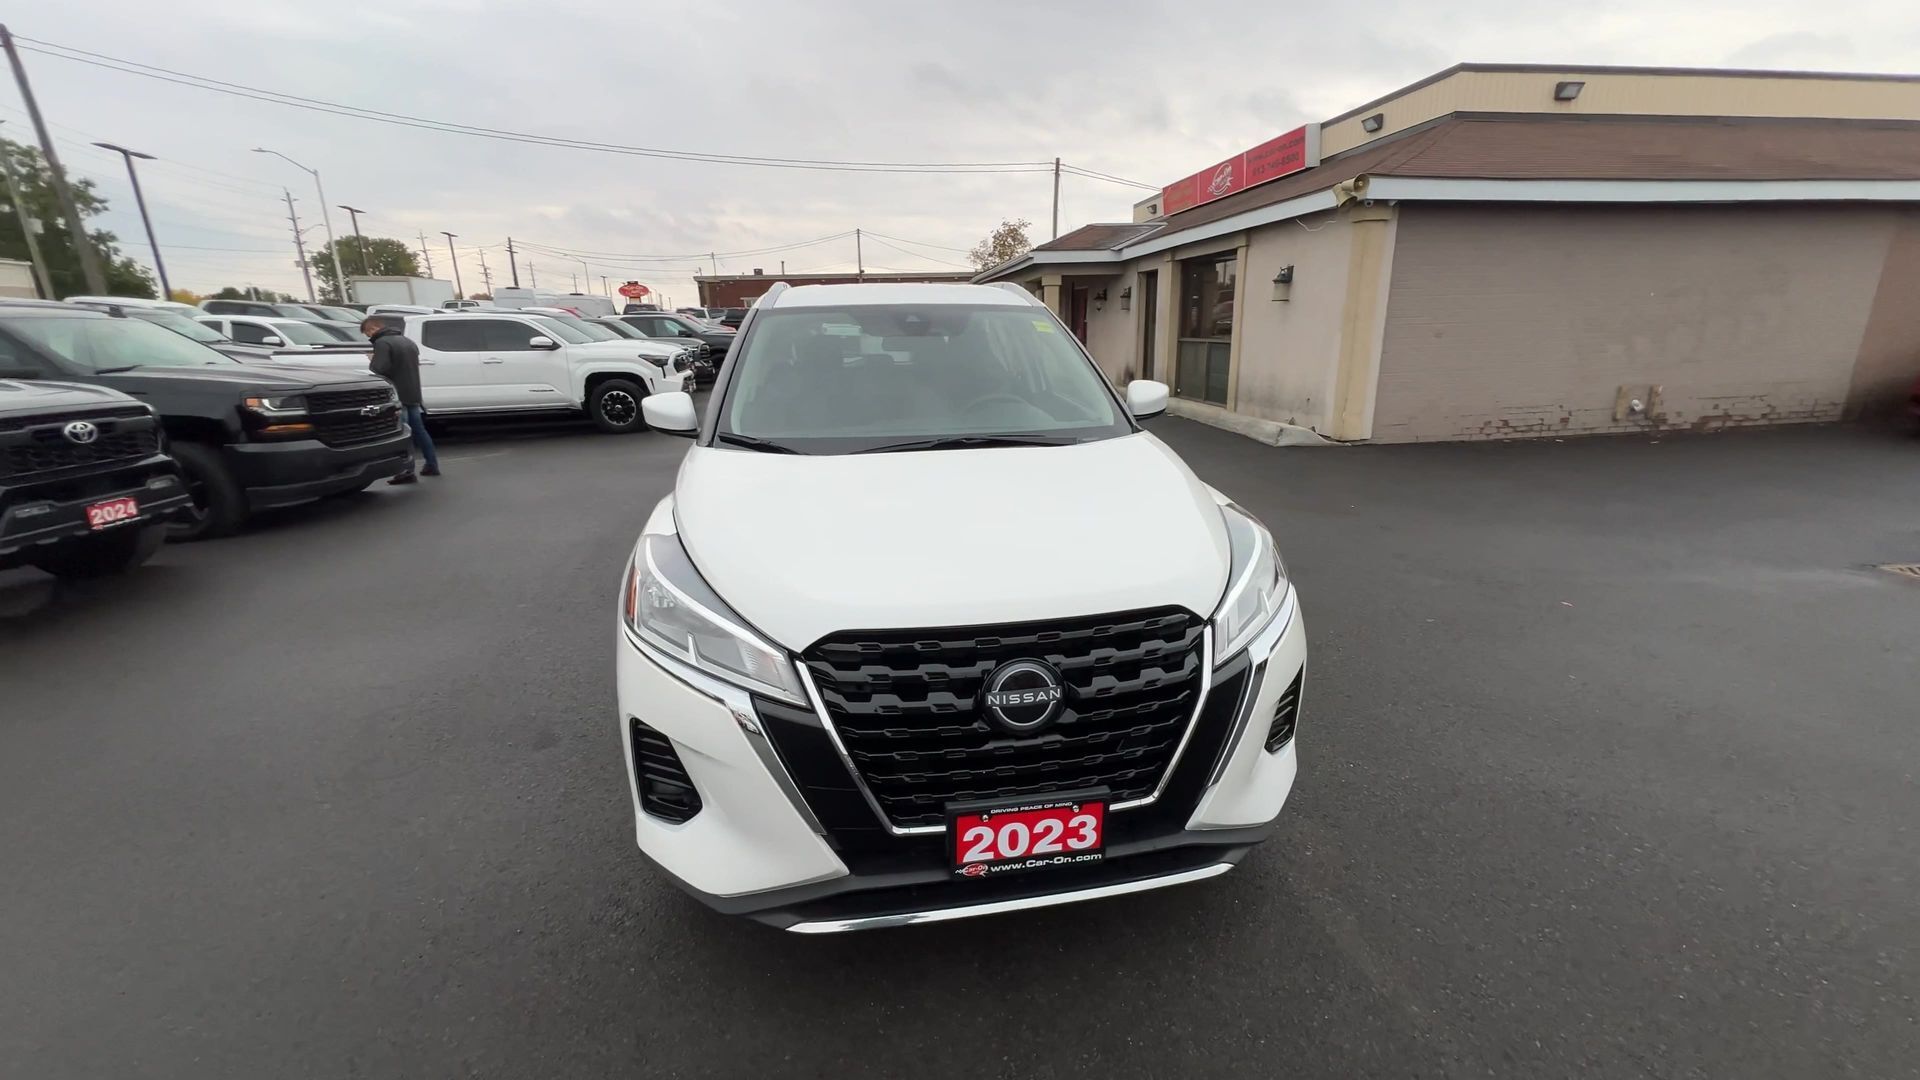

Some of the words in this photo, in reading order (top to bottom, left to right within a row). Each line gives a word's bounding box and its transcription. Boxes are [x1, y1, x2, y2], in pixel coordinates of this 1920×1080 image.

[90, 500, 138, 525] 2024
[987, 688, 1061, 705] NISSAN
[962, 814, 1098, 863] 2023
[990, 853, 1102, 872] www.Car-On.com
